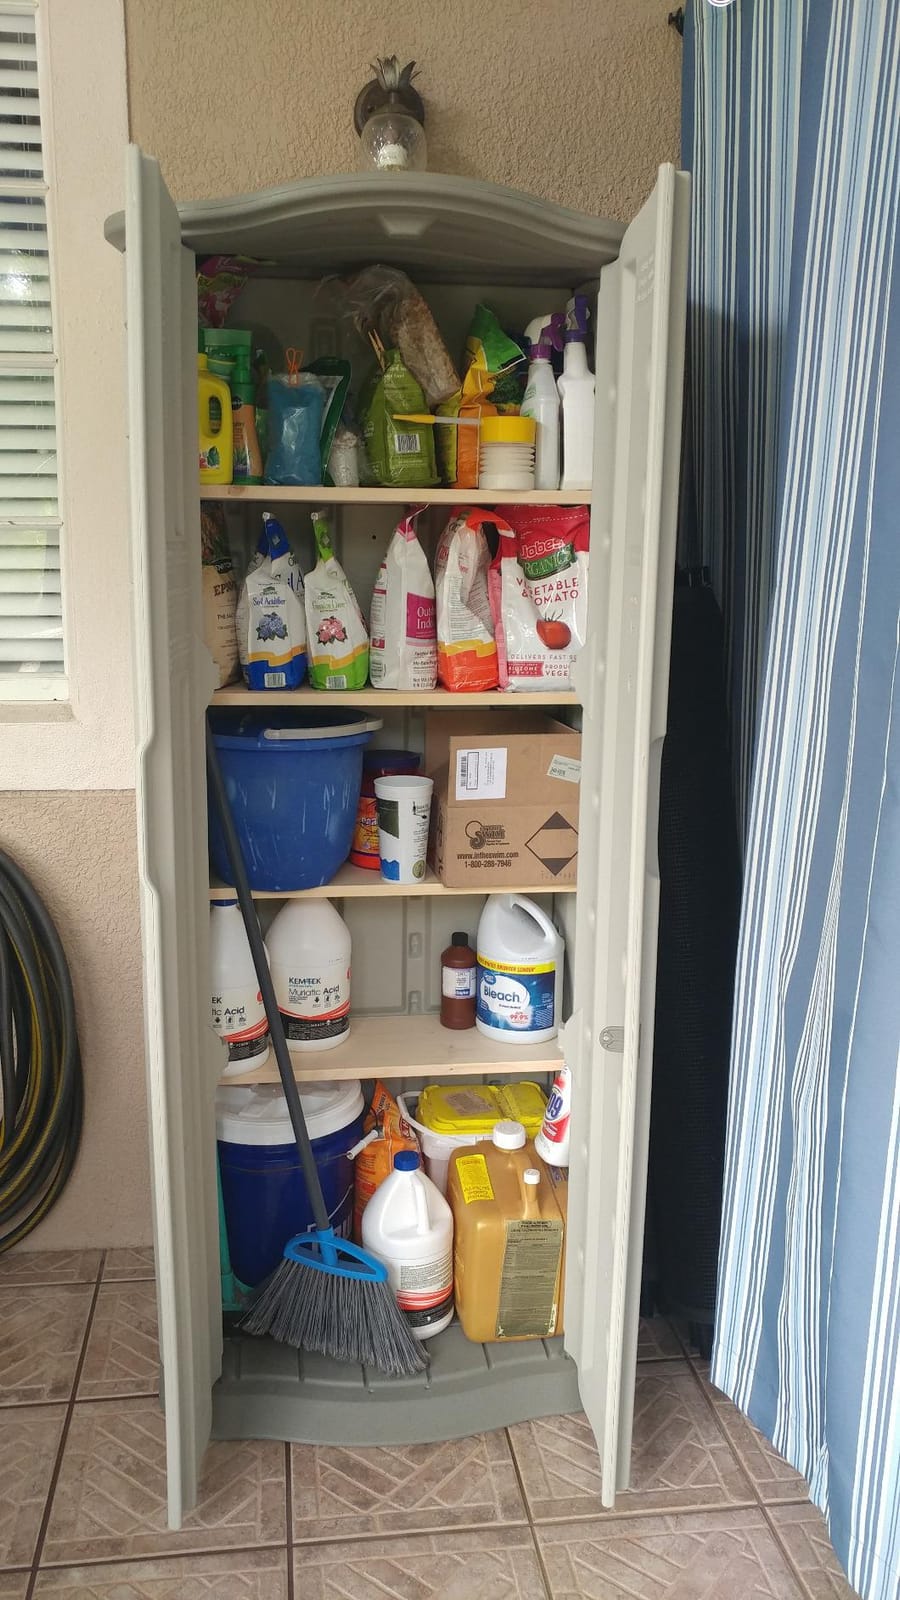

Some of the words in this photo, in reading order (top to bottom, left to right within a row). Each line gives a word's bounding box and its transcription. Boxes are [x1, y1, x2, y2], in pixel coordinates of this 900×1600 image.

[534, 589, 579, 606] OMATO
[456, 852, 519, 860] www.intheswim.com
[288, 987, 321, 996] Muriatic
[322, 984, 340, 995] Acid
[483, 985, 521, 1004] Bleach
[224, 1005, 245, 1016] Acid
